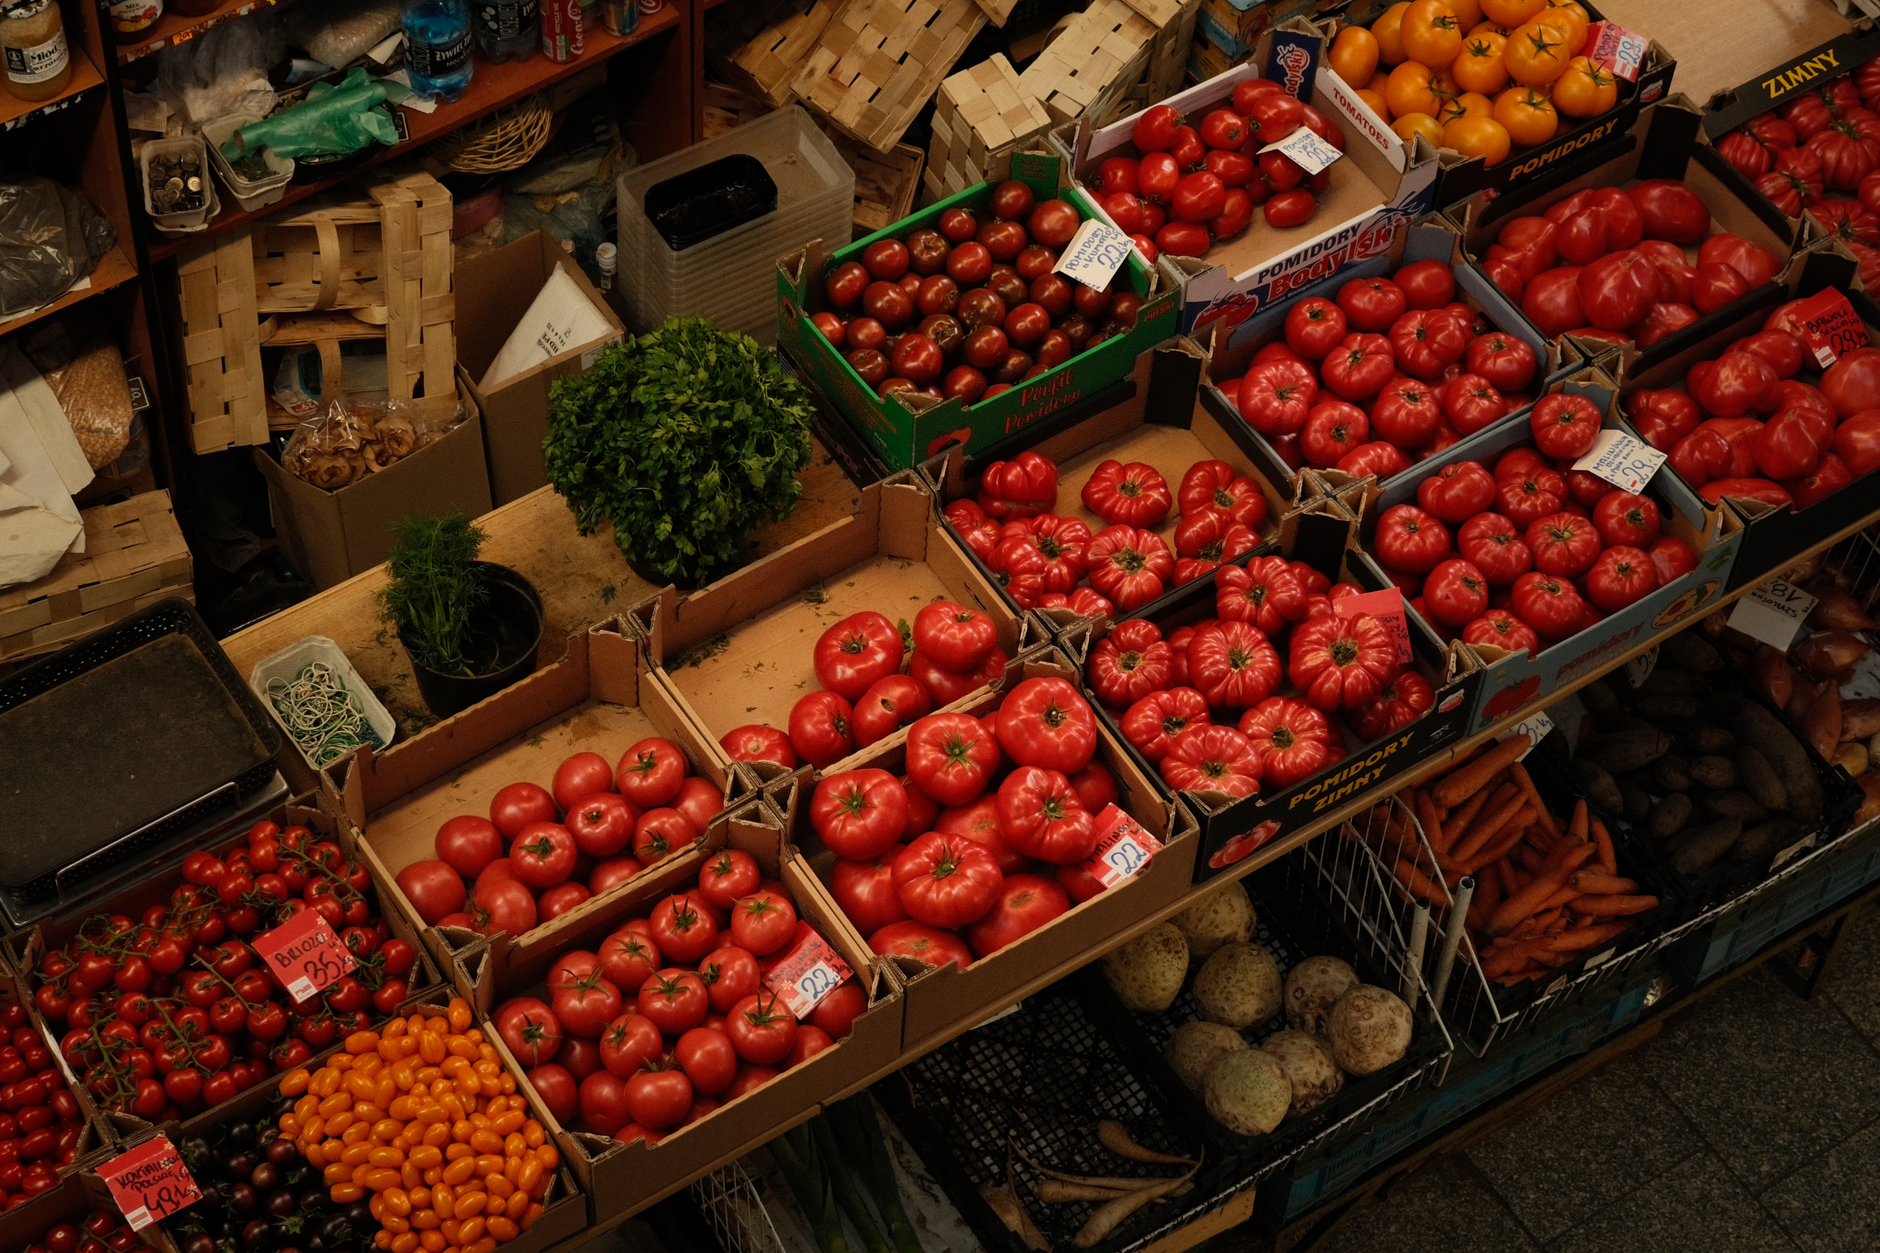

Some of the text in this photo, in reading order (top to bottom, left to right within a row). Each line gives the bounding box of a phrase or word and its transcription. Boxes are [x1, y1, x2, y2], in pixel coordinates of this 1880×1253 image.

[553, 12, 562, 33] RECYCLE
[568, 0, 584, 55] Coca-C
[1210, 18, 1233, 40] MANGO
[1762, 49, 1840, 99] ZIMNY
[1333, 87, 1389, 150] TOMATOES
[1508, 117, 1619, 182] POMIDORY
[1257, 222, 1363, 285] POMIDORY
[1265, 214, 1412, 303] Bodylski
[1830, 328, 1857, 358] 29
[1005, 388, 1082, 435] Pomidory
[1555, 622, 1645, 681] pomidory
[1288, 731, 1415, 811] POMIDORY
[1312, 763, 1388, 813] ZIMNY
[1110, 842, 1147, 875] 22
[303, 951, 341, 987] 35
[800, 968, 838, 1000] 22
